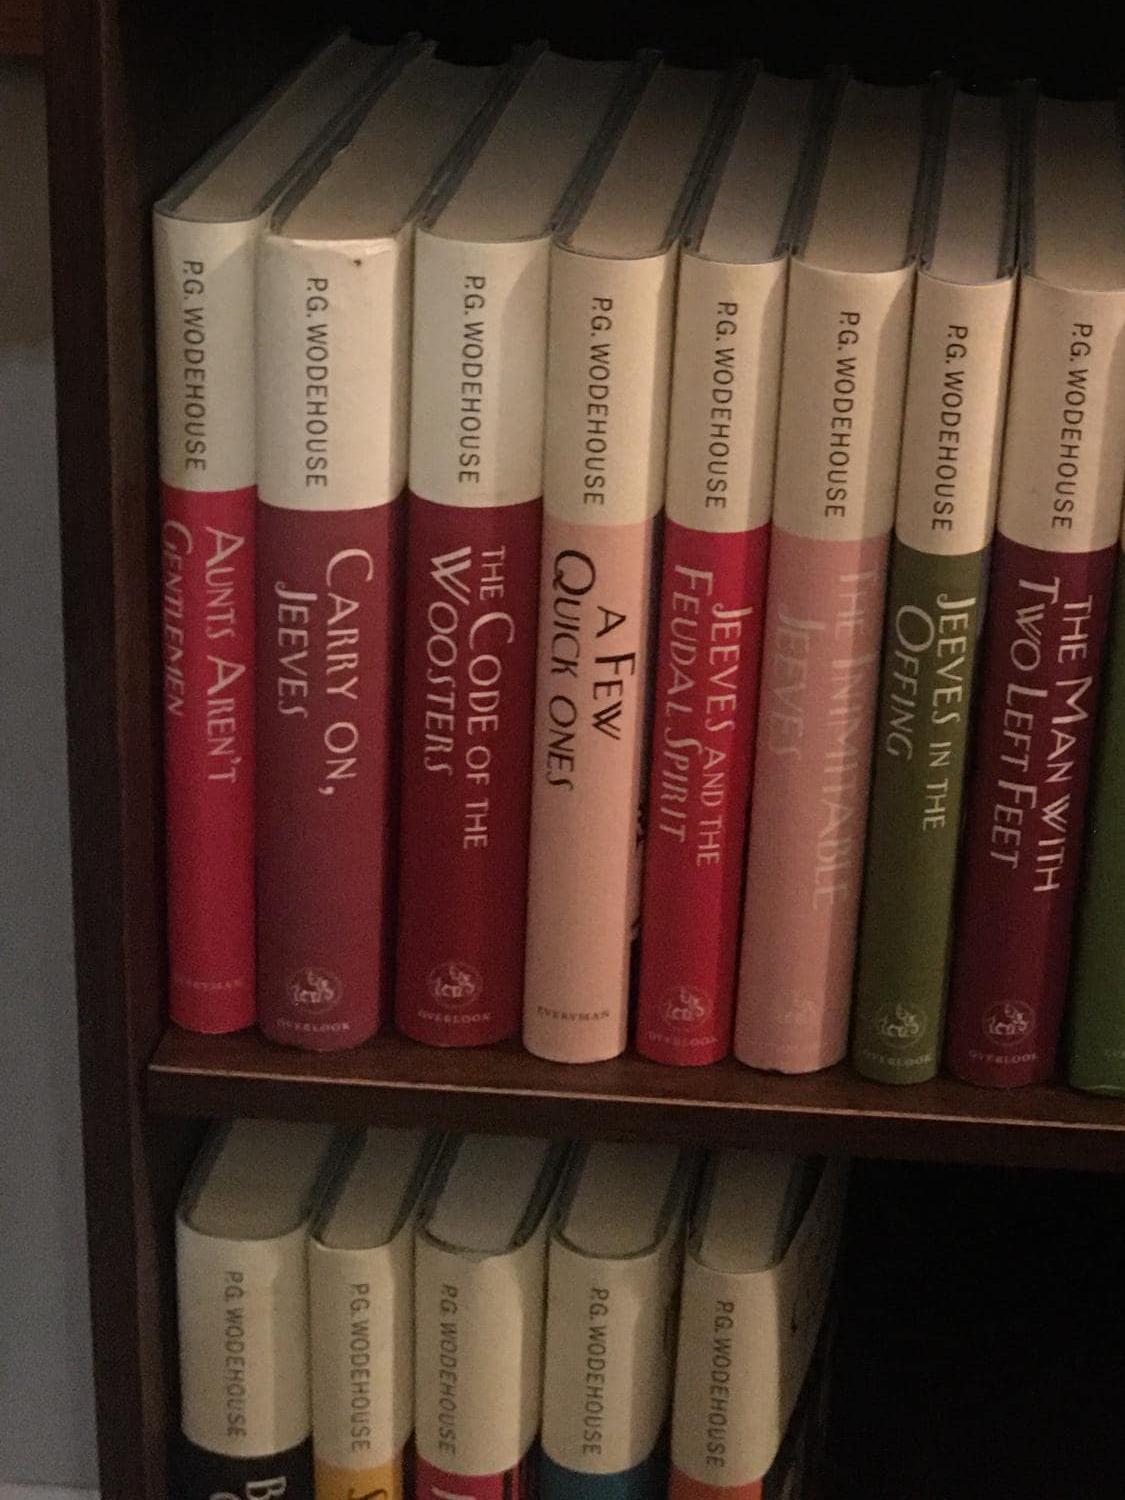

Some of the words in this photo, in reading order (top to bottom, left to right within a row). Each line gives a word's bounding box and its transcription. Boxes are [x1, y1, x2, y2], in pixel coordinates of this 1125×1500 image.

[183, 261, 204, 299] P.G.
[306, 278, 328, 317] P.G.
[464, 276, 485, 315] P.G.
[591, 298, 613, 336] P.G.
[716, 302, 738, 341] P.G.
[838, 312, 860, 350] P.G.
[184, 307, 206, 470] WODEHOUSE
[946, 325, 968, 363] P.G.
[1070, 323, 1093, 361] P.G.
[306, 324, 328, 486] WODEHOUSE
[459, 322, 484, 483] WODEHOUSE
[584, 344, 610, 505] WODEHOUSE
[706, 348, 735, 508] WODEHOUSE
[825, 357, 856, 517] WODEHOUSE
[932, 371, 964, 530] WODEHOUSE
[1052, 369, 1088, 529] WODEHOUSE
[163, 520, 192, 716] GENTLEMEN
[205, 526, 244, 639] AUNTS
[326, 548, 373, 700] CARRY
[478, 546, 506, 598] THE
[550, 549, 596, 677] QUICK
[598, 606, 627, 638] A
[1009, 576, 1060, 672] TWO
[274, 580, 317, 718] JEEVES
[424, 547, 473, 778] WOOSTERS
[467, 611, 515, 736] CODE
[664, 565, 713, 718] FEUDAL
[707, 602, 754, 733] JEEVES
[886, 603, 935, 762] OFFING
[930, 592, 976, 725] JEEVES
[1057, 594, 1094, 665] THE
[207, 654, 246, 784] AREN'T
[546, 695, 580, 791] ONES
[591, 652, 635, 740] FEW
[1000, 683, 1049, 771] LEFT
[1046, 673, 1093, 799] MAN
[318, 722, 359, 795] ON,
[464, 747, 491, 787] OF
[658, 725, 704, 843] SPIRIT
[700, 749, 730, 807] AND
[922, 781, 947, 832] THE
[929, 742, 952, 769] IN
[463, 799, 488, 849] THE
[696, 816, 722, 868] THE
[990, 780, 1037, 868] FEET
[1032, 795, 1068, 893] WITH
[417, 1010, 495, 1025] OVERLOOK
[537, 1006, 611, 1022] EVERYMAN
[225, 1309, 247, 1437] WODEHOUSE
[350, 1320, 371, 1451] WODEHOUSE
[438, 1322, 458, 1454] WODEHOUSE
[582, 1326, 606, 1454] WODEHOUSE
[706, 1338, 732, 1467] WODEHOUSE
